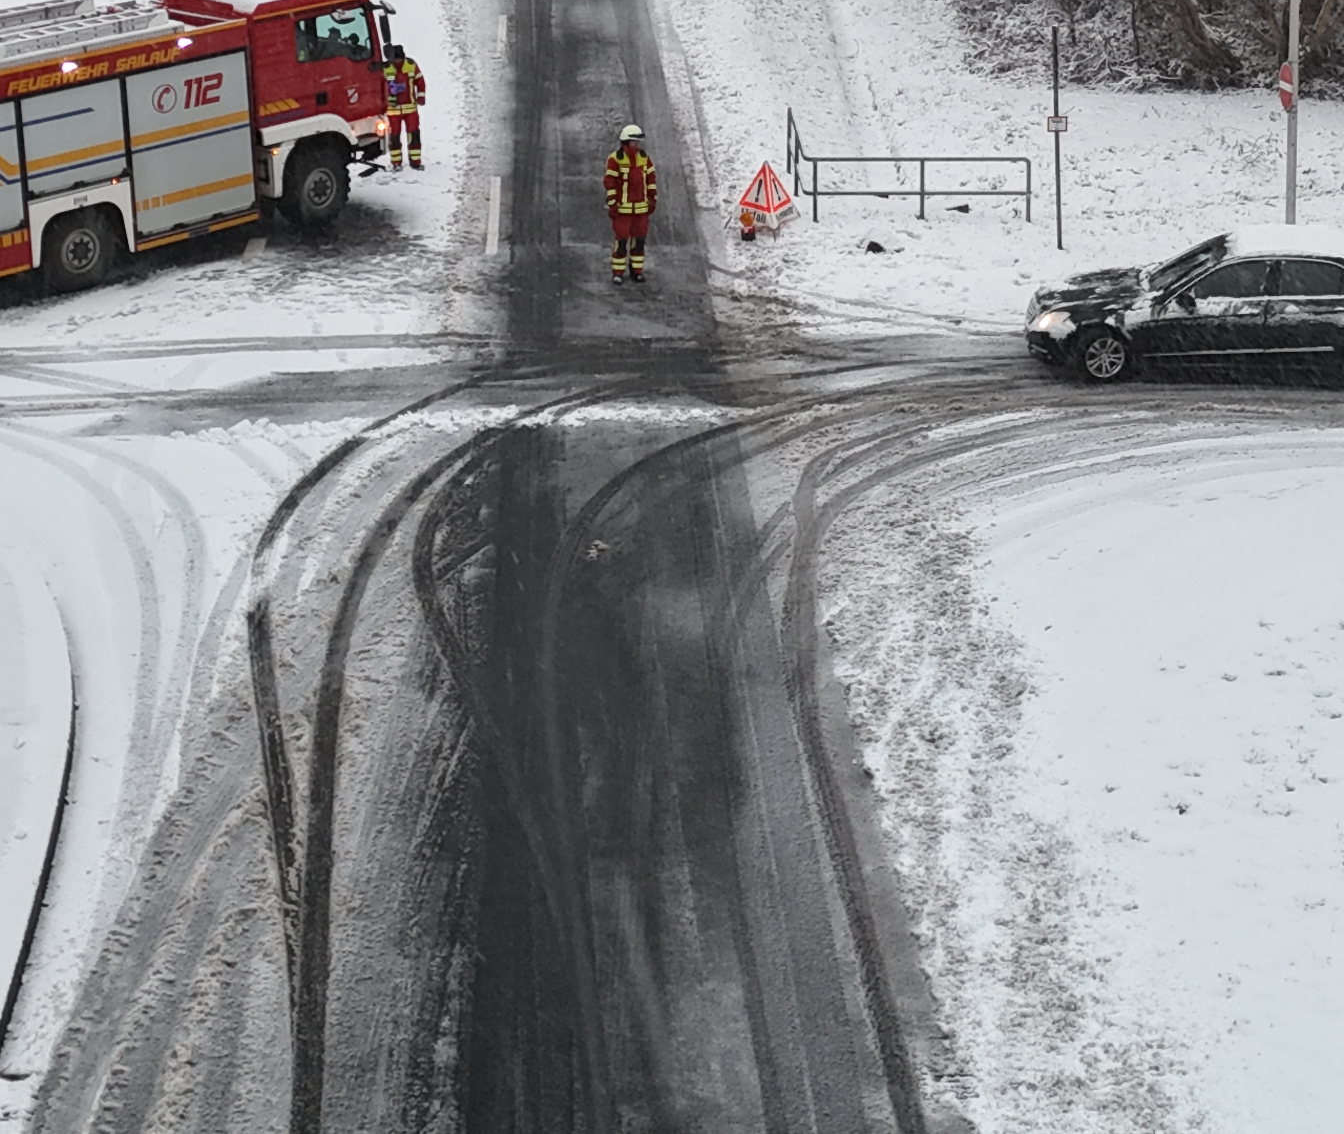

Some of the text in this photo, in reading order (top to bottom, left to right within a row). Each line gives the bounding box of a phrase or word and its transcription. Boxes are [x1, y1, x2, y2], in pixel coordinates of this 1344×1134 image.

[7, 47, 182, 96] FEUERWEHR SAILAUF
[183, 72, 224, 109] 112
